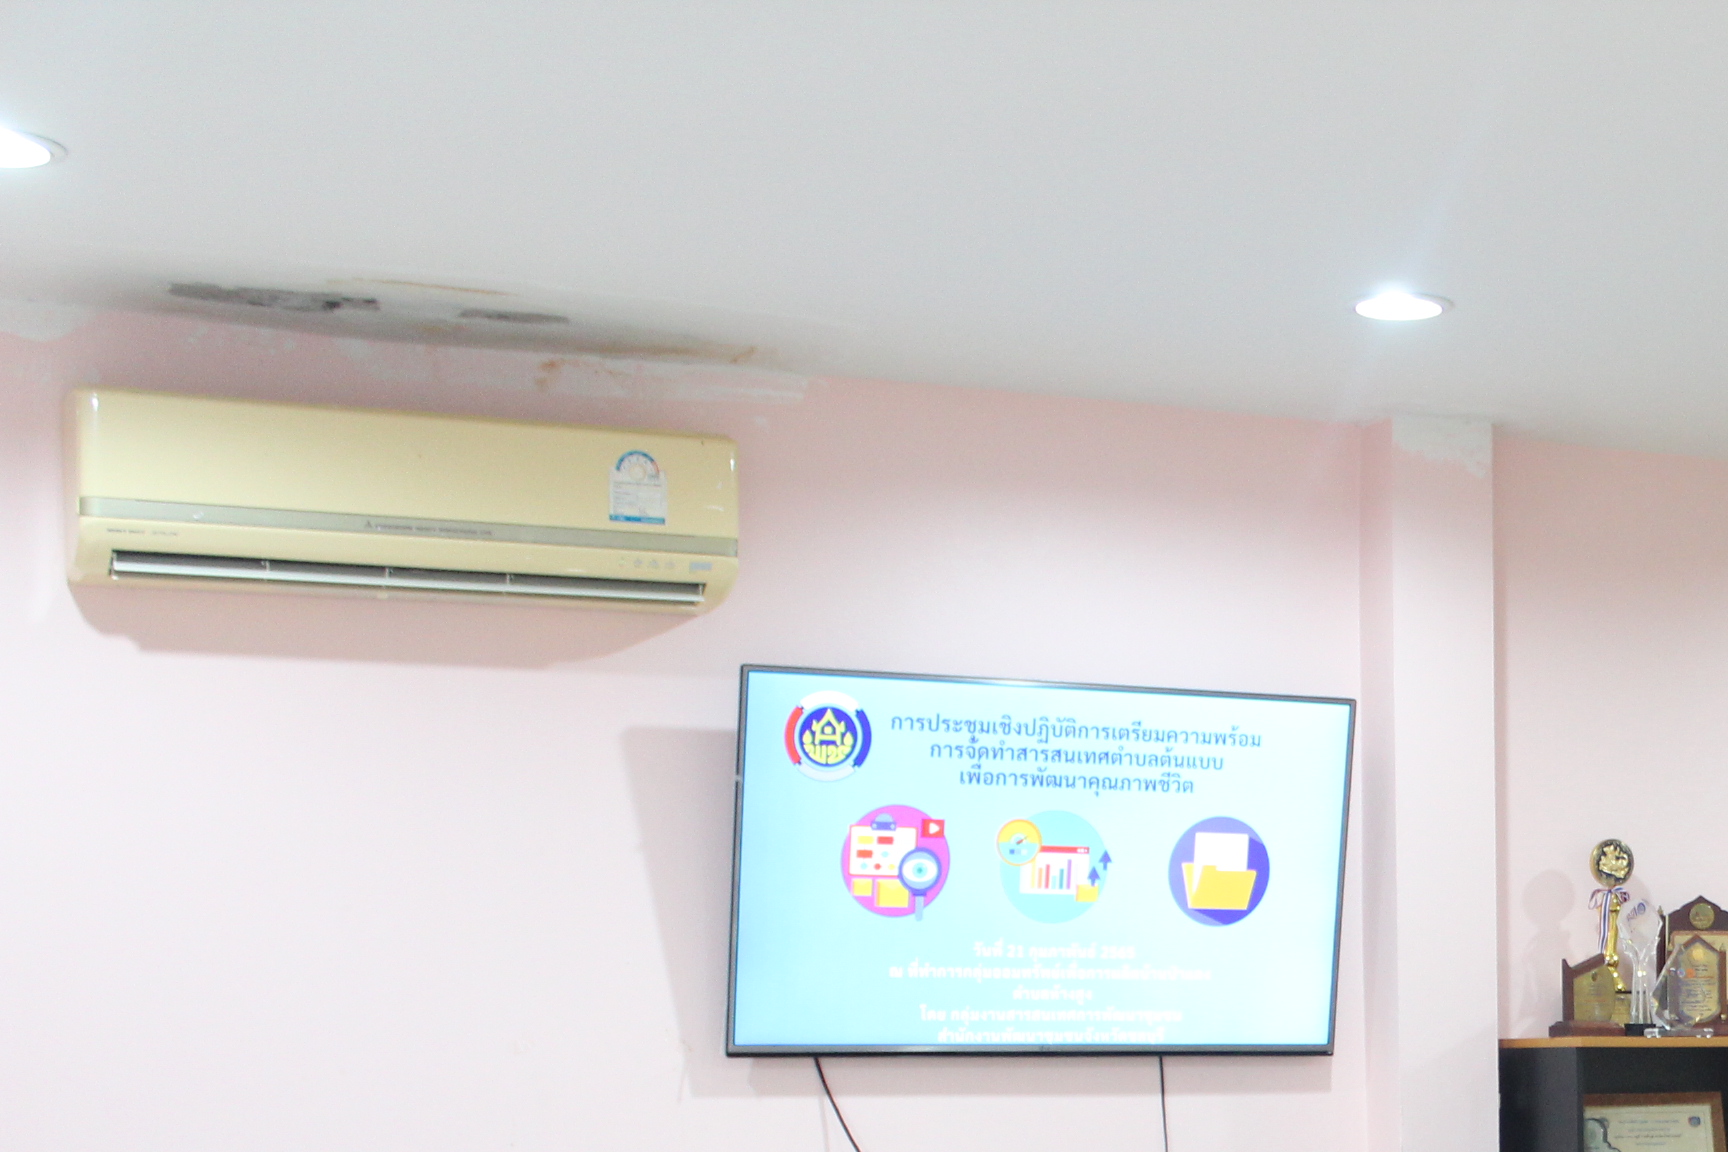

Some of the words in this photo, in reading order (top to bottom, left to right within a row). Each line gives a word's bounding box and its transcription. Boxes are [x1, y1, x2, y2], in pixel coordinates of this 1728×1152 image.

[891, 713, 1262, 748] การประชุมเชิงปฏิบัติการเตรียมความพร้อม
[930, 737, 1224, 771] การจัดทำสารสนเทศตำบลต้นแบบ
[959, 760, 1195, 798] เพื่อการพัฒนาคุณภาพชีวิต
[973, 937, 1004, 958] วันที่
[1007, 944, 1024, 958] 21
